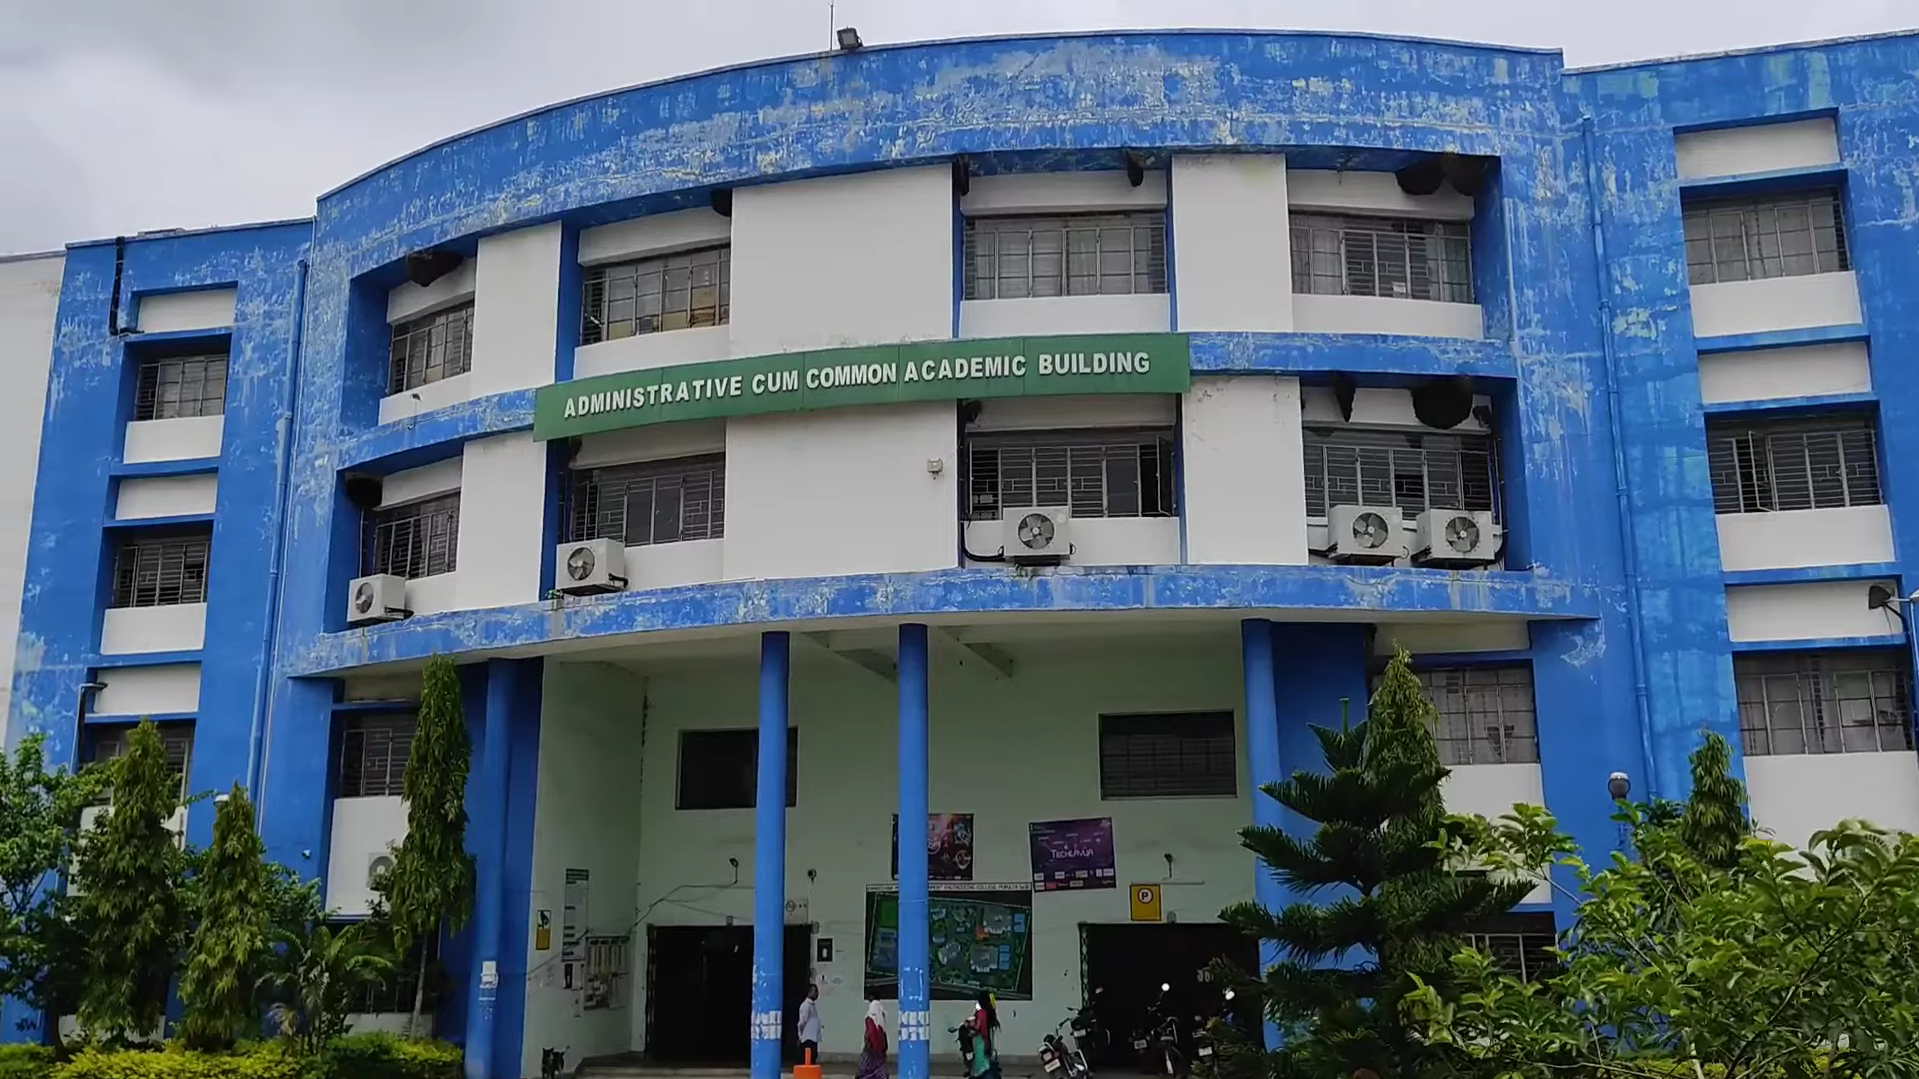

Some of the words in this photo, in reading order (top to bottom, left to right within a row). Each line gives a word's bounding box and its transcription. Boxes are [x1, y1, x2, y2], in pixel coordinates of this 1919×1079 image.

[564, 375, 742, 418] ADMINISTRATIVE
[752, 369, 798, 394] CUM
[806, 363, 897, 389] COMMON
[904, 355, 1027, 382] ACADEMIC
[1038, 352, 1151, 375] BUILDING
[1141, 891, 1149, 900] P
